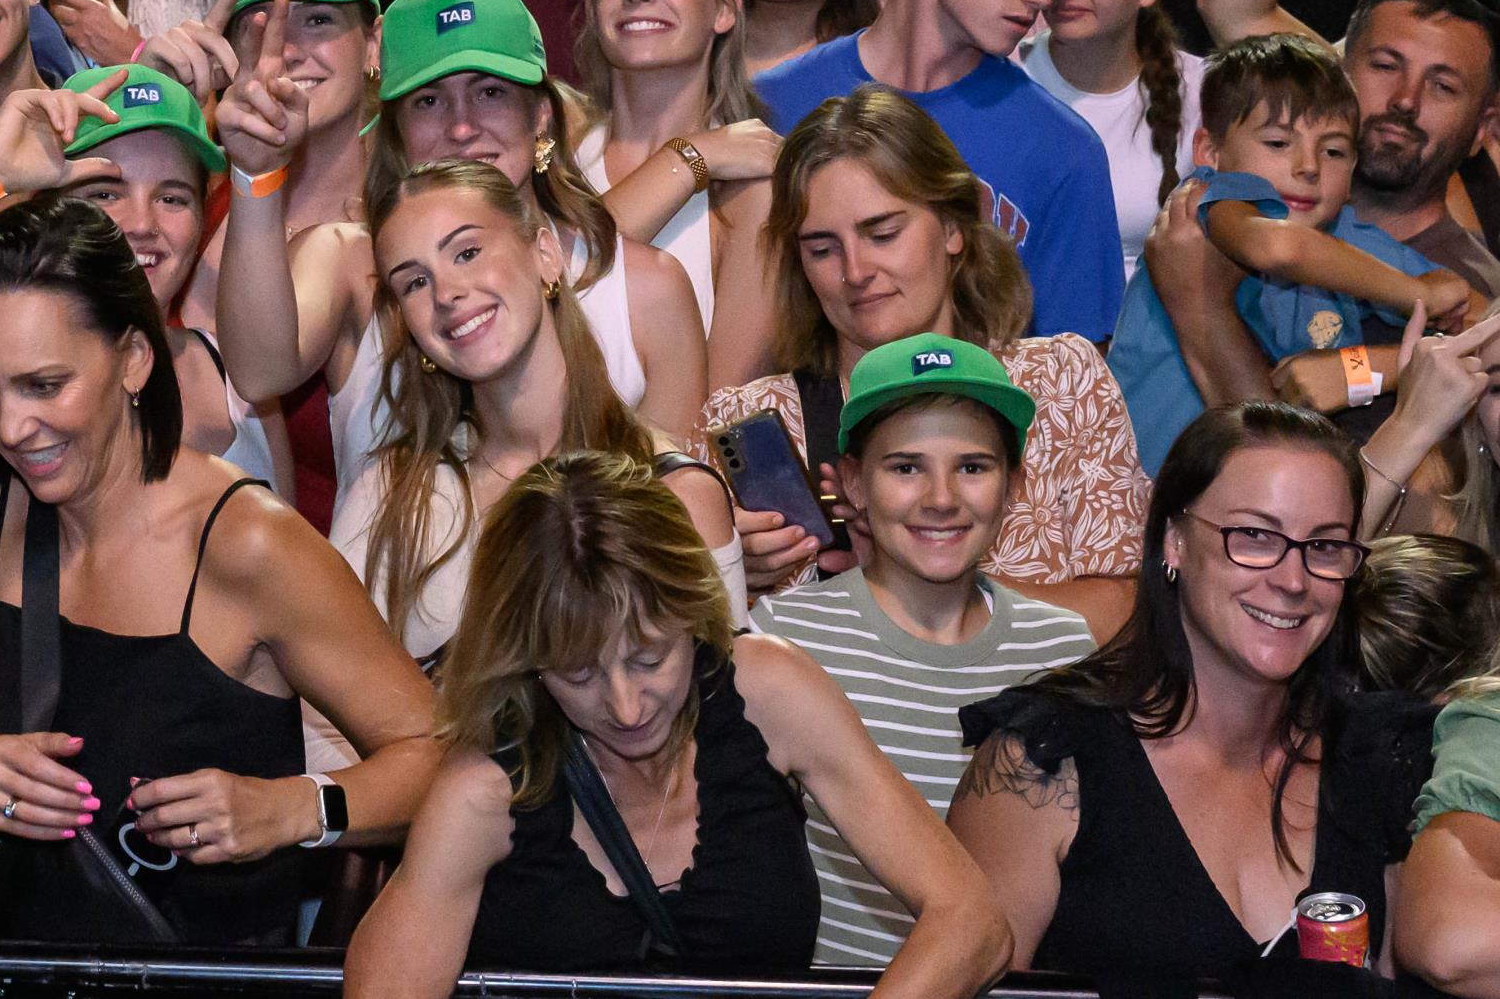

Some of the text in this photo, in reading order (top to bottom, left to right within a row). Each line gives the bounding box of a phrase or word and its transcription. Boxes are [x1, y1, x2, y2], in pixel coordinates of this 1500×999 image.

[440, 9, 472, 23] TAB
[127, 87, 159, 101] TAB
[916, 353, 951, 365] TAB
